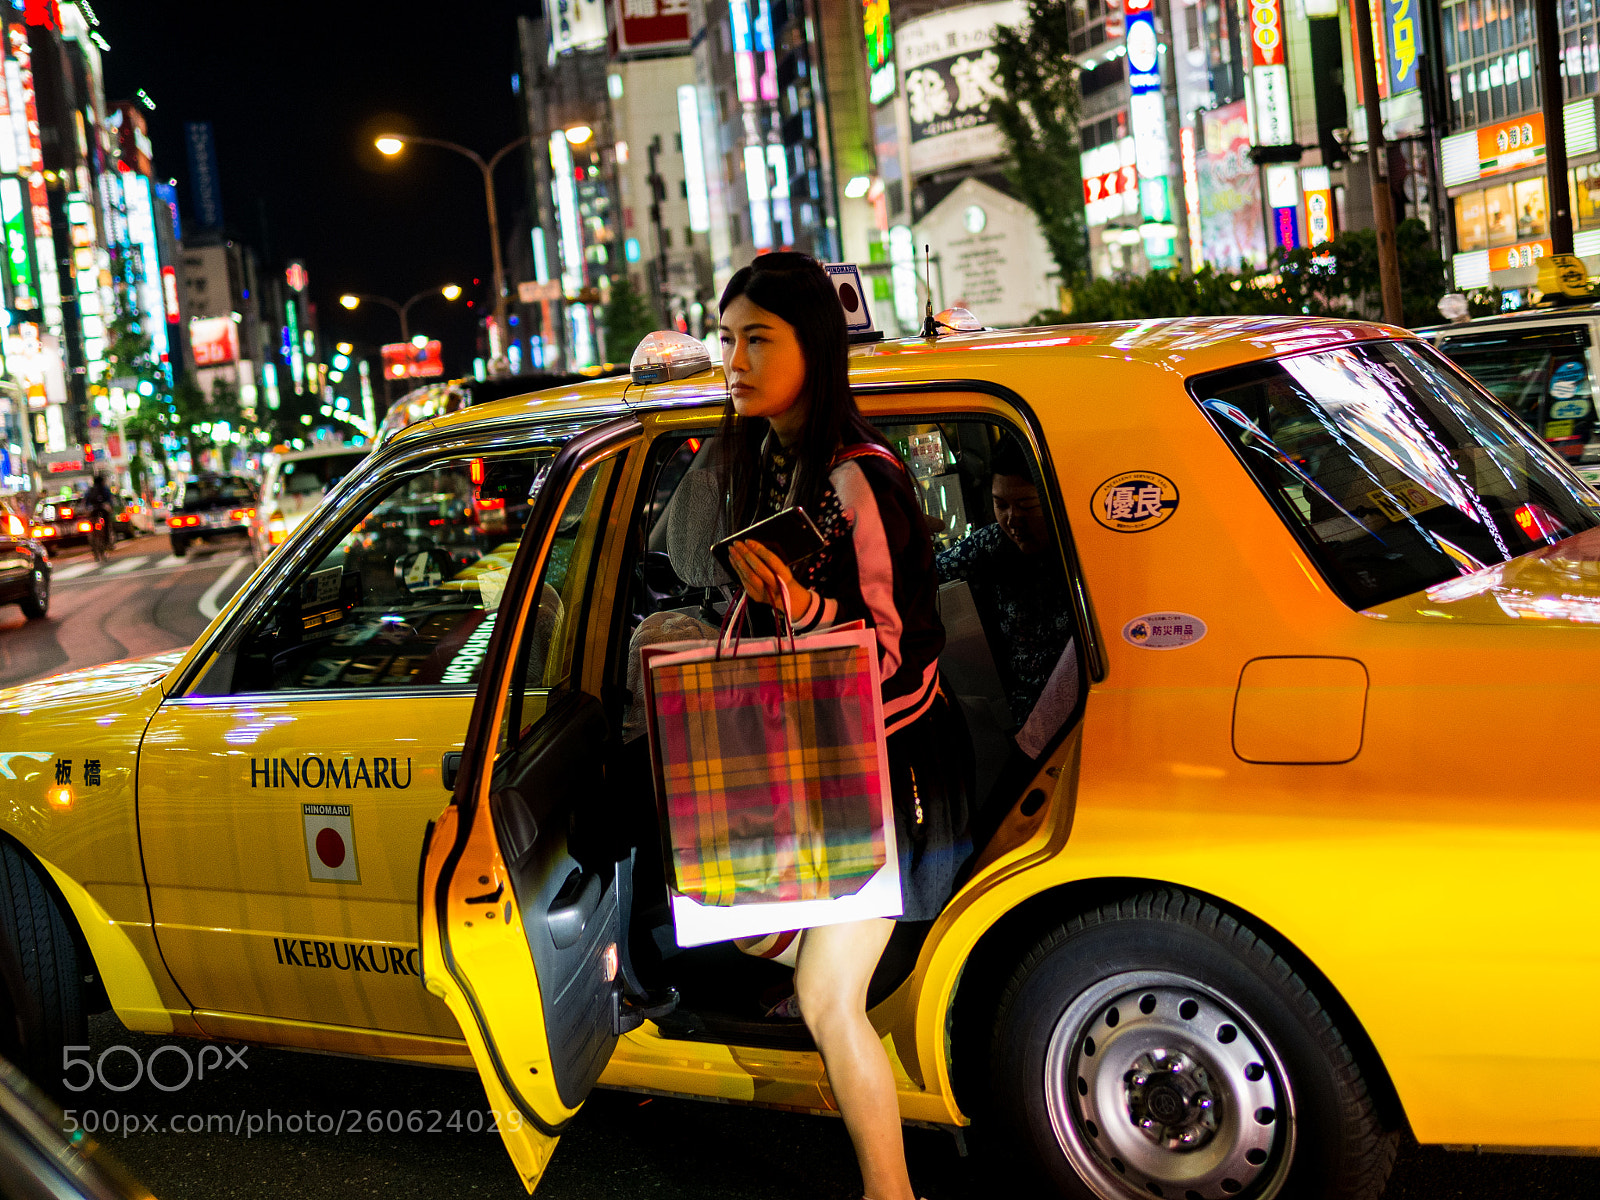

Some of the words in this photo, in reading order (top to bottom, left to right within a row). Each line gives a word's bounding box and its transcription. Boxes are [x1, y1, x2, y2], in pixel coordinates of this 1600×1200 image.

[1104, 484, 1162, 520] 優良
[1152, 624, 1194, 636] 防災用品
[55, 758, 101, 787] 板橋
[250, 756, 412, 790] HINOMARU
[304, 804, 350, 816] HINOMARU
